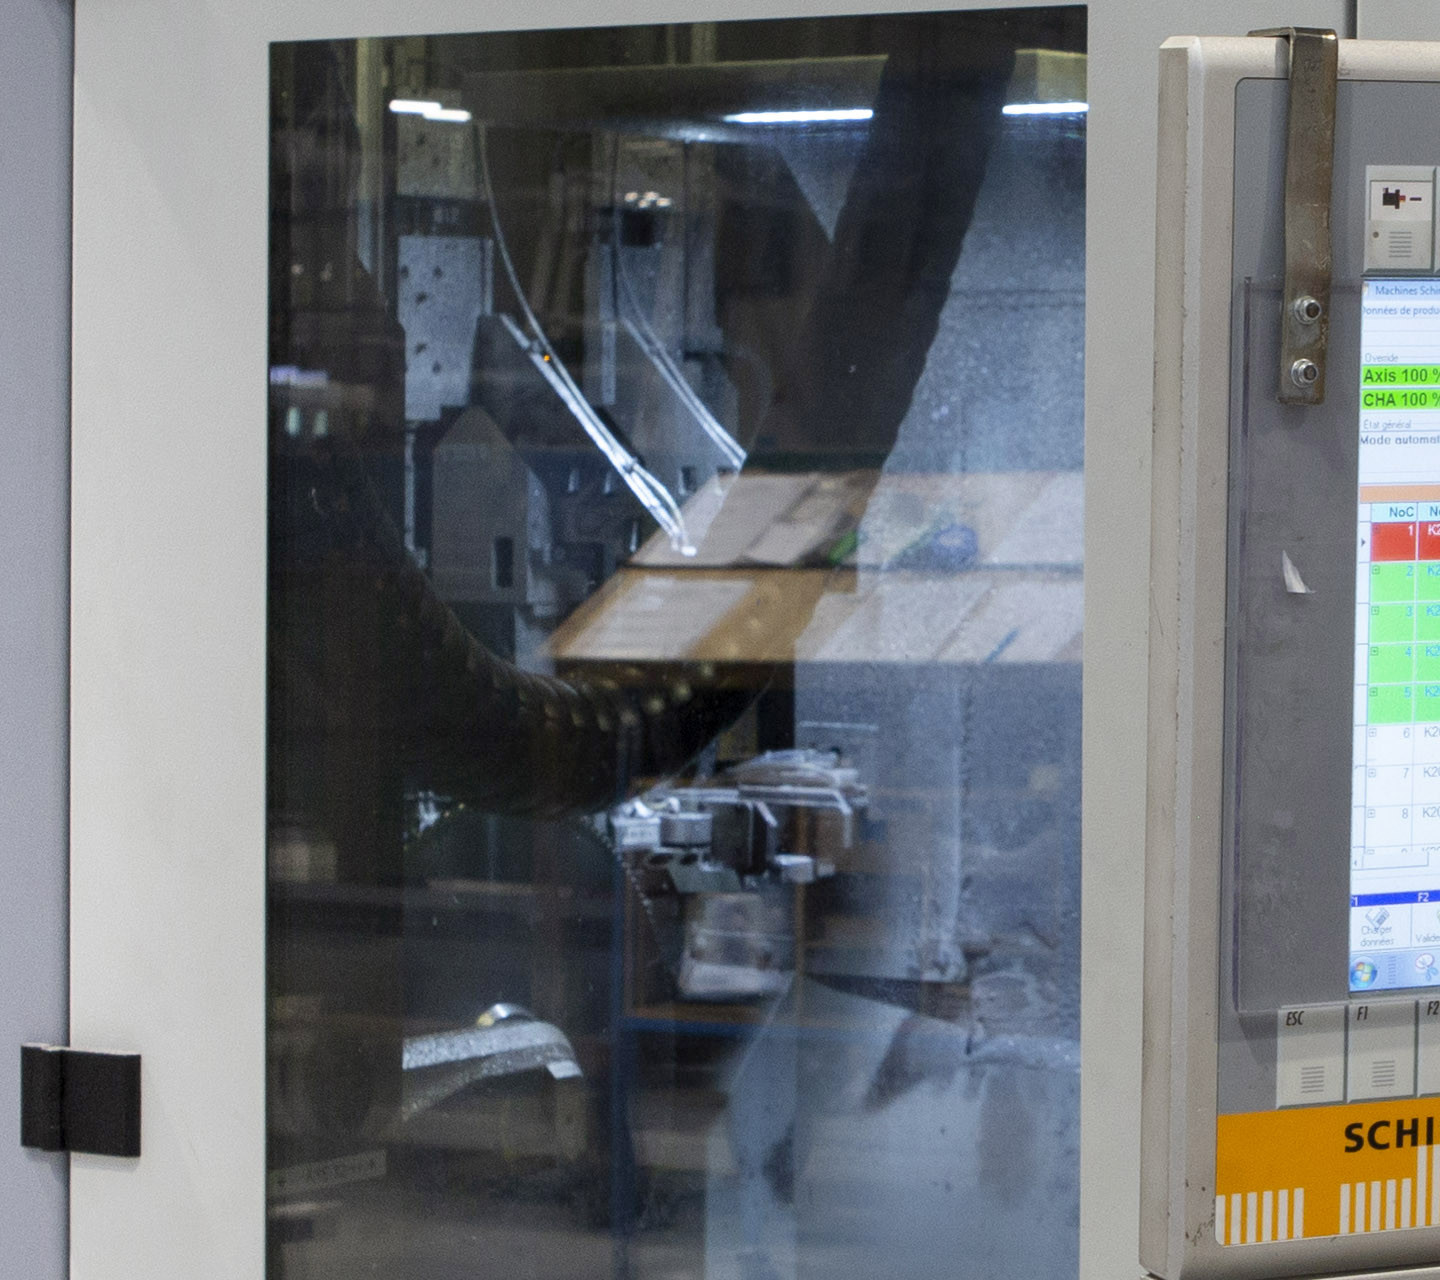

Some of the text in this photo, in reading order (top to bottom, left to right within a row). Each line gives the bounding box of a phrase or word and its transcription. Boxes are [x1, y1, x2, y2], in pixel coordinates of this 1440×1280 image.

[1375, 285, 1418, 296] Machines
[1400, 305, 1410, 315] de
[1363, 369, 1396, 383] Axis
[1402, 369, 1428, 382] 100
[1363, 393, 1396, 406] CHA
[1401, 392, 1427, 406] 100
[1360, 435, 1392, 445] Mode
[1389, 506, 1414, 518] NoC
[1407, 524, 1414, 535] 1
[1401, 808, 1409, 820] 8
[1285, 1010, 1305, 1026] ESC
[1356, 1005, 1369, 1020] F1
[1427, 1000, 1440, 1016] F2
